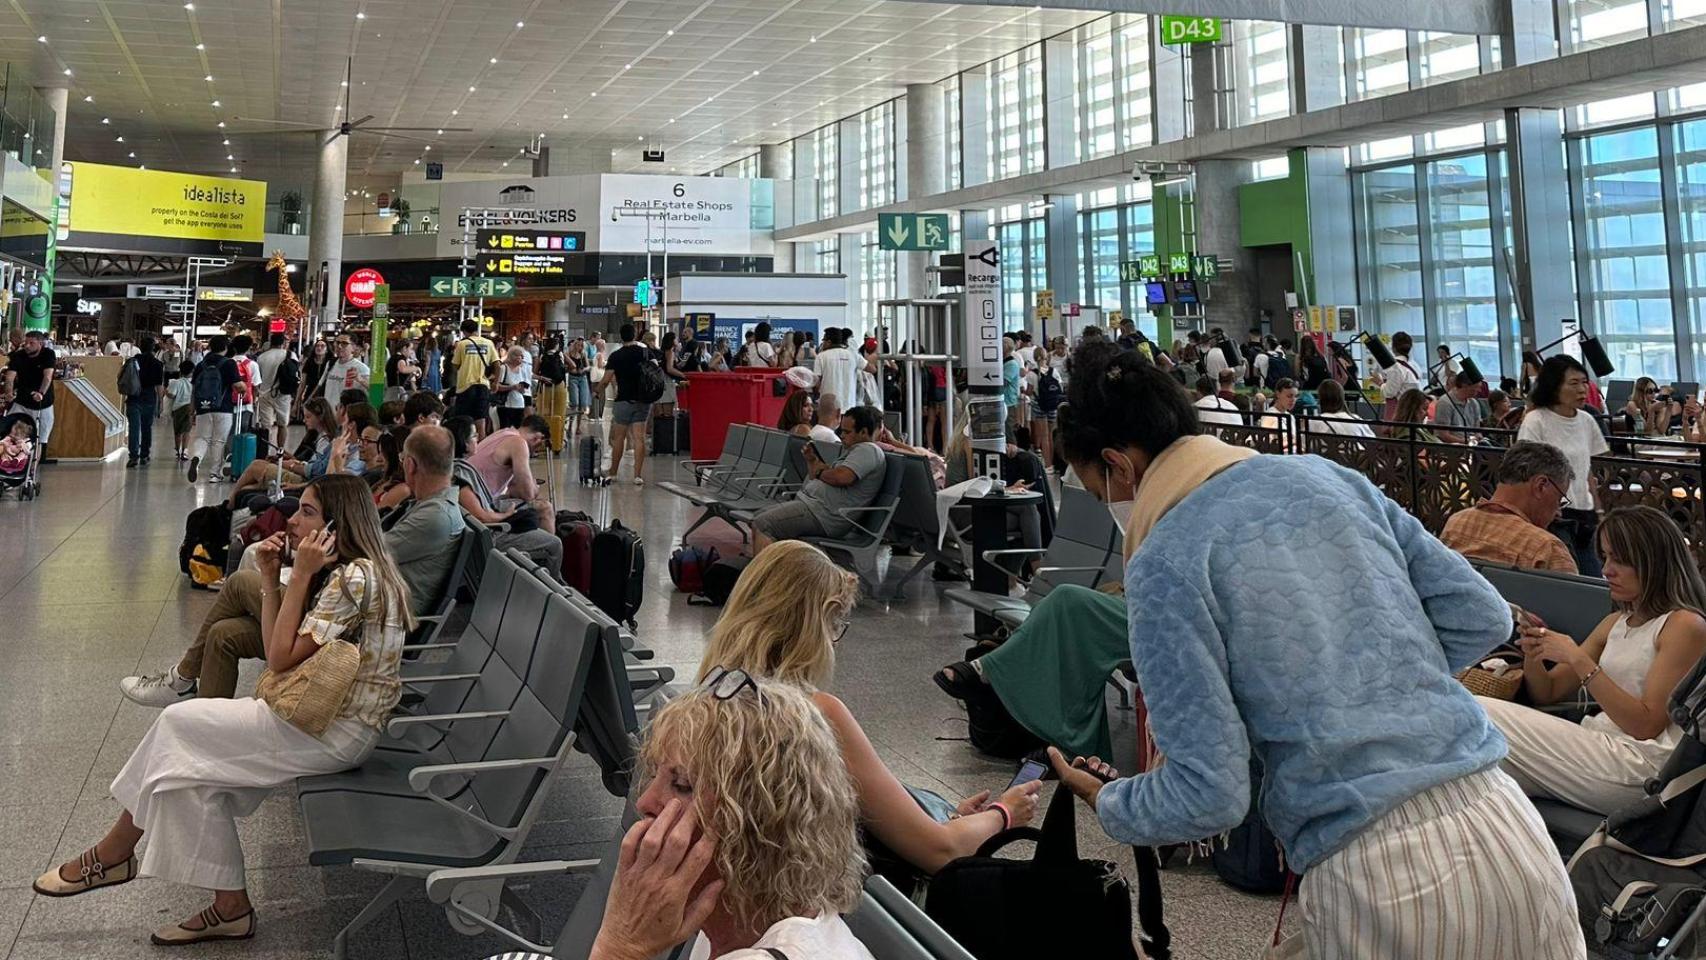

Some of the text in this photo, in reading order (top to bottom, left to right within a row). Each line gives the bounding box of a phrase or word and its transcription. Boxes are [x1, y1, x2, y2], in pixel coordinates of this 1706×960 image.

[1170, 18, 1215, 40] D43
[183, 184, 245, 205] idealista
[673, 183, 685, 197] 6
[624, 199, 733, 212] Real Estate Shops
[151, 207, 178, 217] property
[189, 209, 199, 217] the
[200, 210, 218, 218] Costa
[660, 212, 711, 222] Marbella
[163, 217, 174, 225] get
[200, 221, 227, 229] everyone
[566, 239, 574, 247] C
[1142, 258, 1158, 272] D42
[1171, 256, 1187, 270] D43
